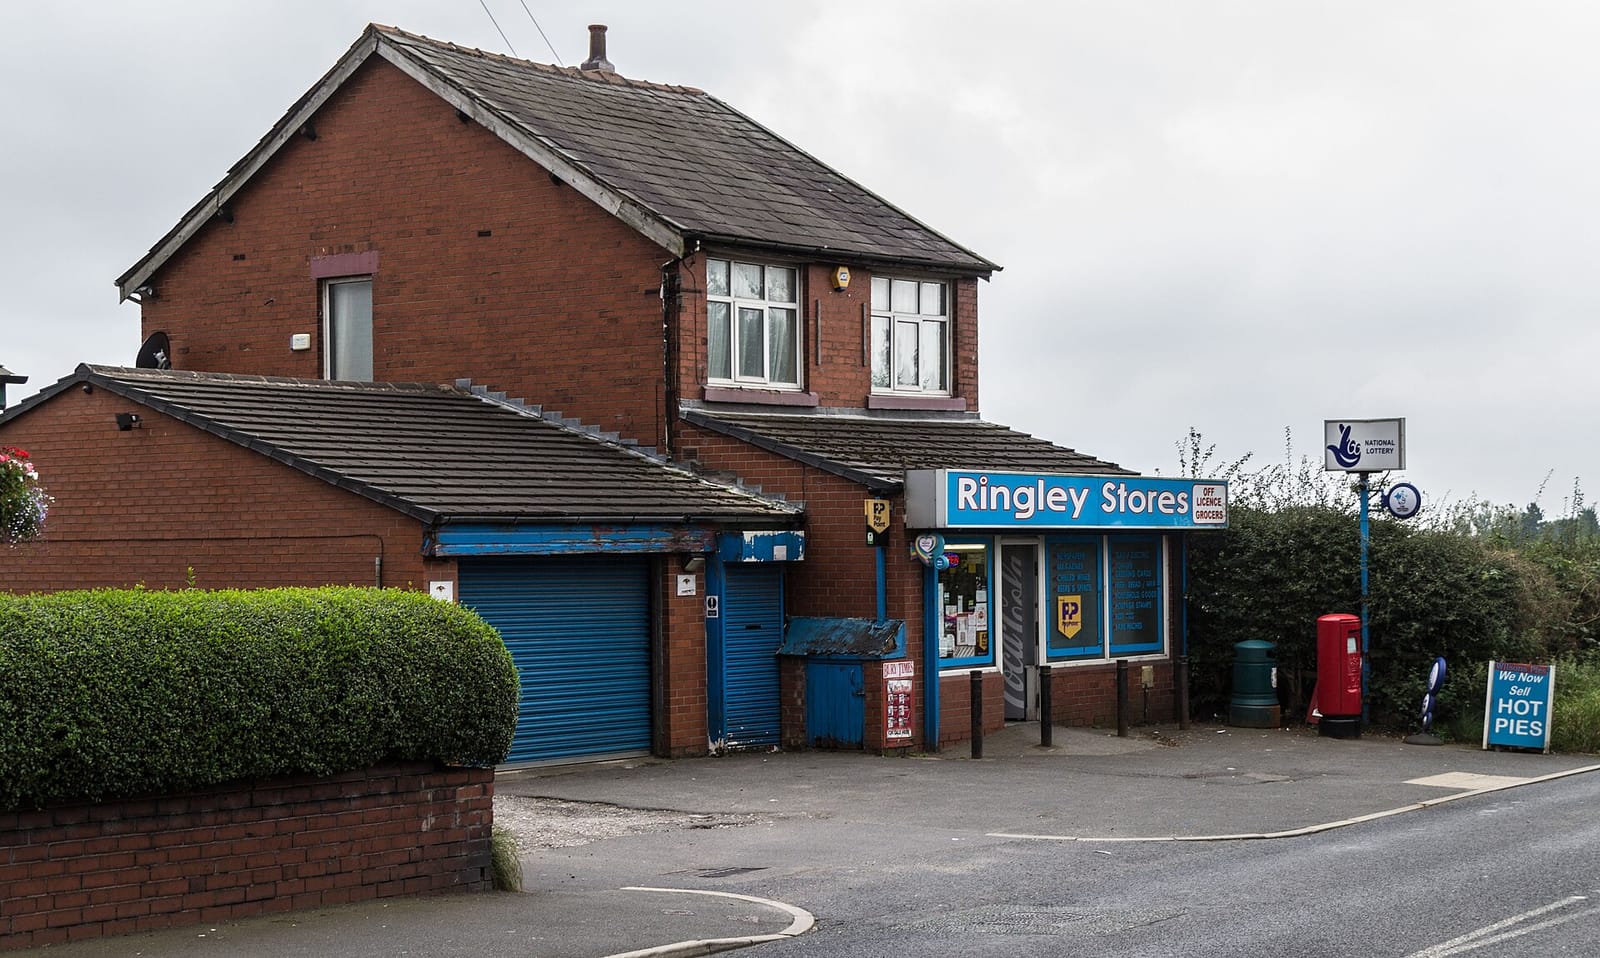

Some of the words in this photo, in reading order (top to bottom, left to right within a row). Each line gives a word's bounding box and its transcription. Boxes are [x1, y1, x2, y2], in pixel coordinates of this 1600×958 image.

[957, 475, 1089, 519] Ringley
[1101, 481, 1189, 515] Stores
[1203, 487, 1215, 496] OFF
[1196, 497, 1222, 506] LICENCE
[1196, 510, 1224, 519] GROCERS
[883, 663, 897, 677] BURY
[899, 662, 913, 676] TIMES
[1499, 671, 1516, 681] We
[1518, 672, 1544, 683] Now
[1509, 685, 1531, 696] Sell
[1498, 698, 1543, 716] HOT
[1495, 718, 1543, 736] PIES
